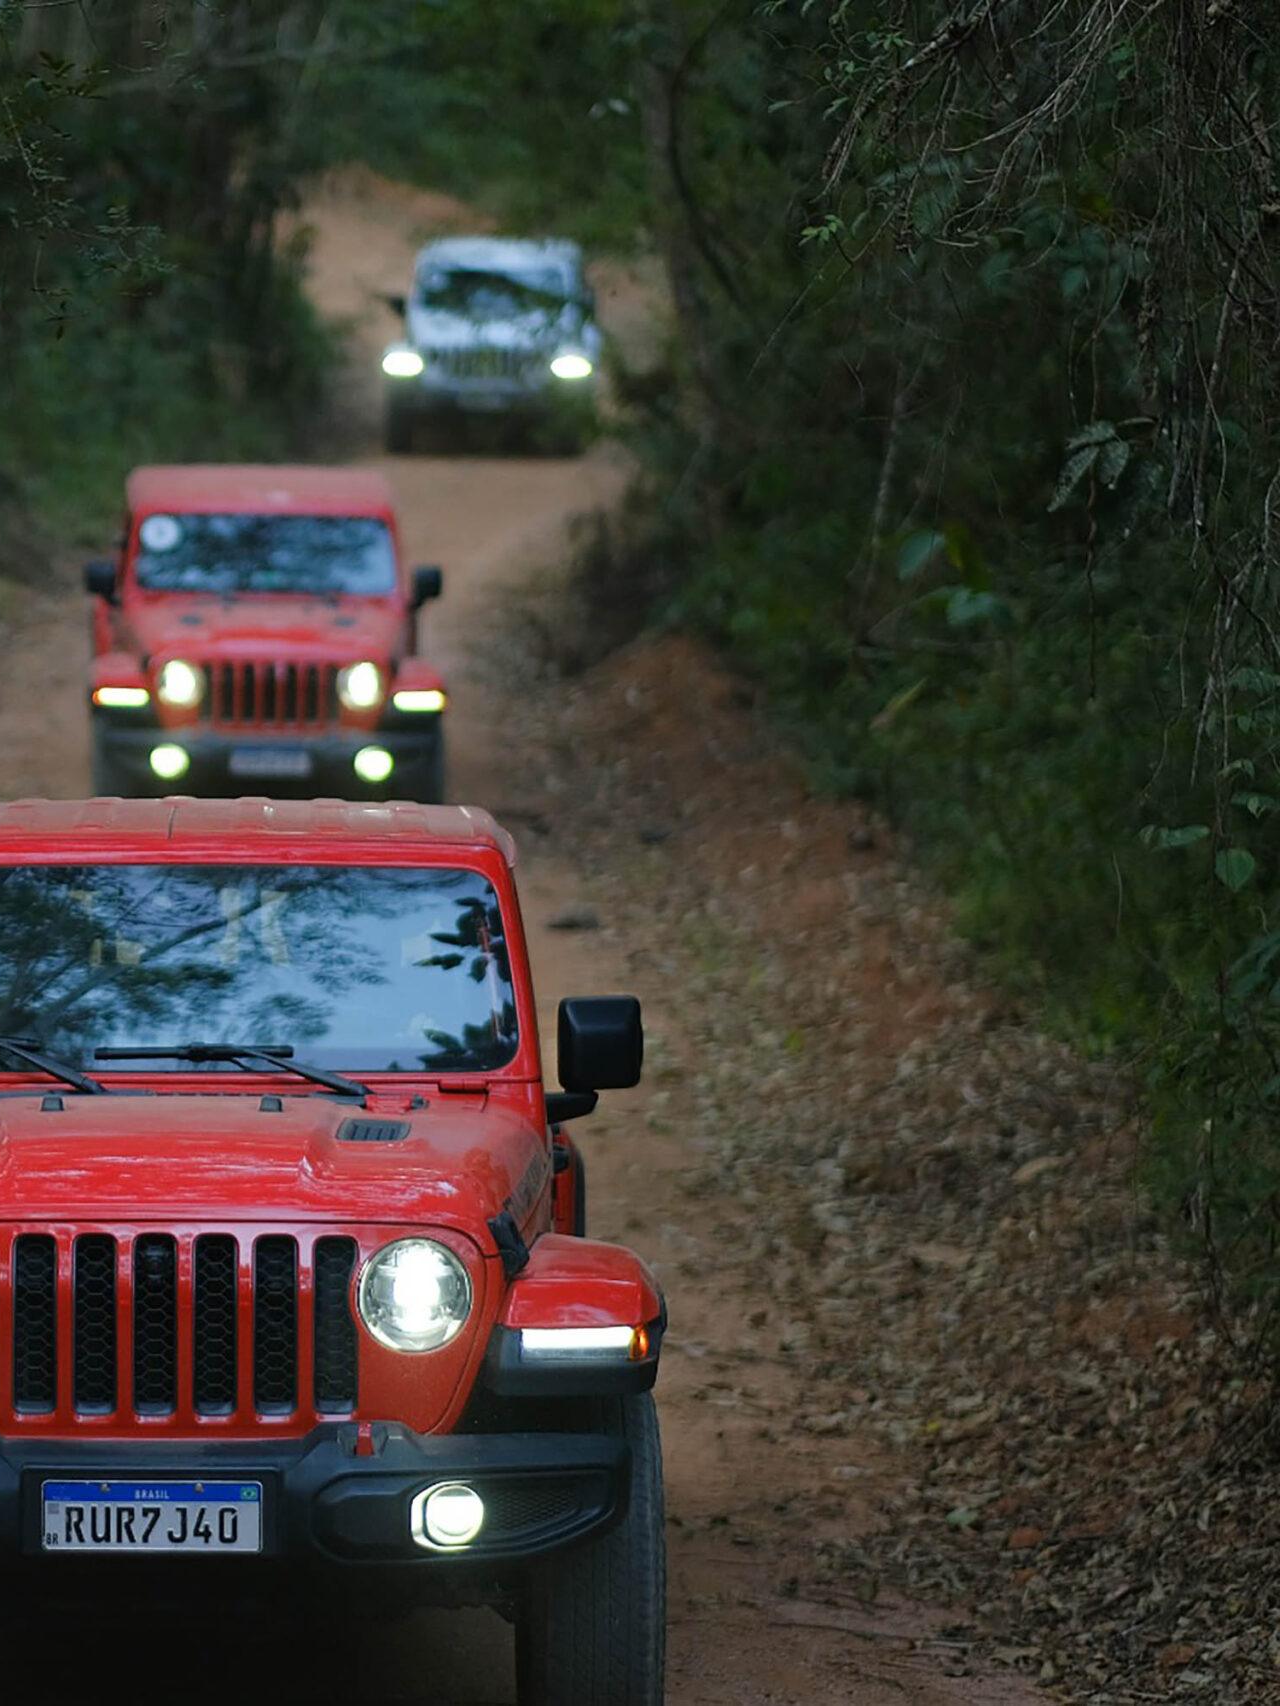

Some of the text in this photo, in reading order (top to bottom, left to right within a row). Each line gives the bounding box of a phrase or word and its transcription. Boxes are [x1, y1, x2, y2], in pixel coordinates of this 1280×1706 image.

[134, 1489, 170, 1500] BRASIL
[65, 1505, 238, 1543] RUR7J40
[46, 1532, 59, 1545] BR
